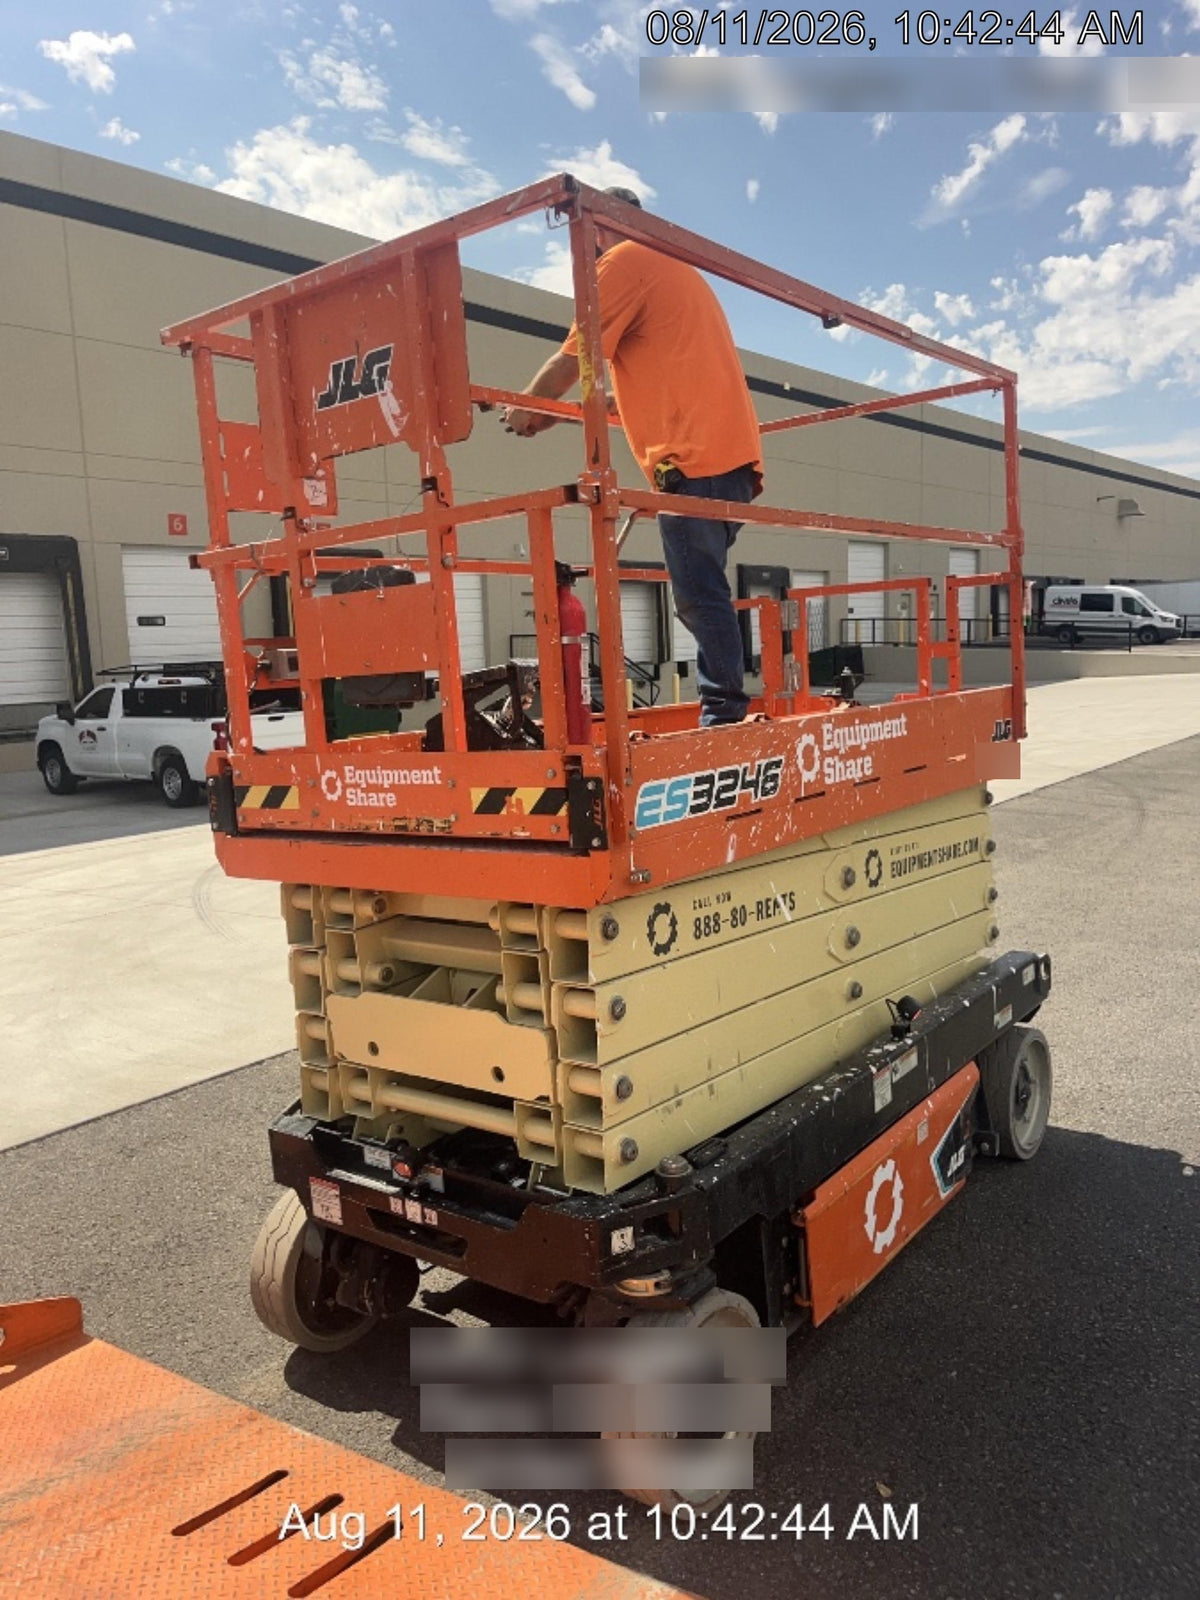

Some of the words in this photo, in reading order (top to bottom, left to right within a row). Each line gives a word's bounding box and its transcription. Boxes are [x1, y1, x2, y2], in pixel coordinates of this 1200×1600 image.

[316, 343, 394, 412] JLG
[173, 516, 183, 532] 6
[821, 712, 908, 755] Equipment
[343, 765, 442, 789] Equipment
[823, 754, 874, 786] Share
[345, 786, 397, 808] Share
[635, 757, 784, 830] ES3246
[890, 836, 979, 879] EQUIPMENTSHARE.COM
